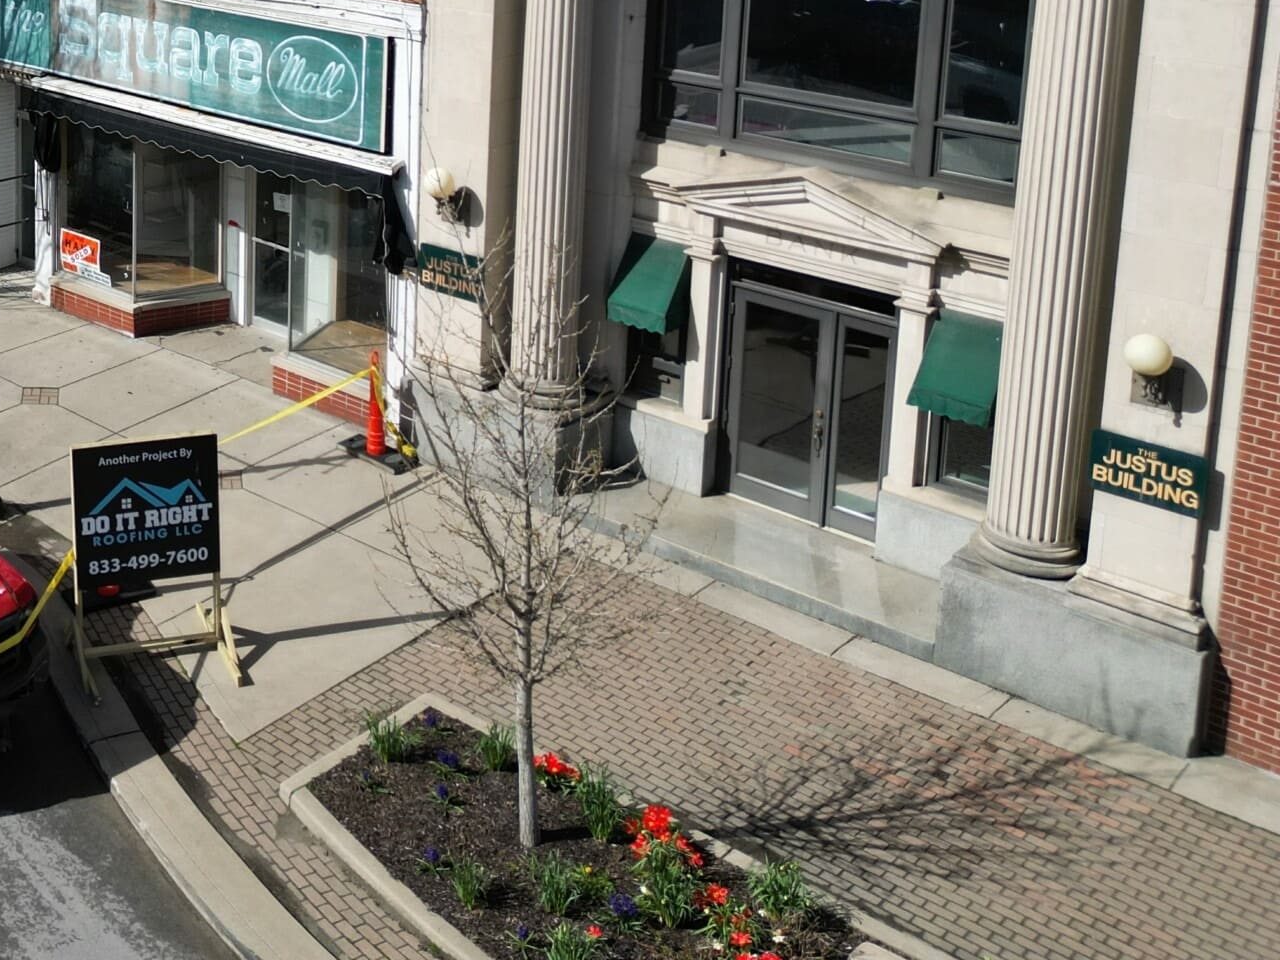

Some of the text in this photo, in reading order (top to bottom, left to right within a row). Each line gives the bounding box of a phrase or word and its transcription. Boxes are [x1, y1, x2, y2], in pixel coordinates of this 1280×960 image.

[279, 47, 347, 99] Mall
[70, 248, 89, 263] SOLD
[98, 447, 192, 467] Another Project By
[1102, 448, 1194, 487] JUSTUS
[1137, 448, 1158, 460] THE
[1092, 463, 1199, 510] BUILDING
[81, 503, 213, 536] DO IT RIGHT
[92, 523, 203, 547] ROOFING LLC
[89, 547, 209, 575] 833-499-7600
